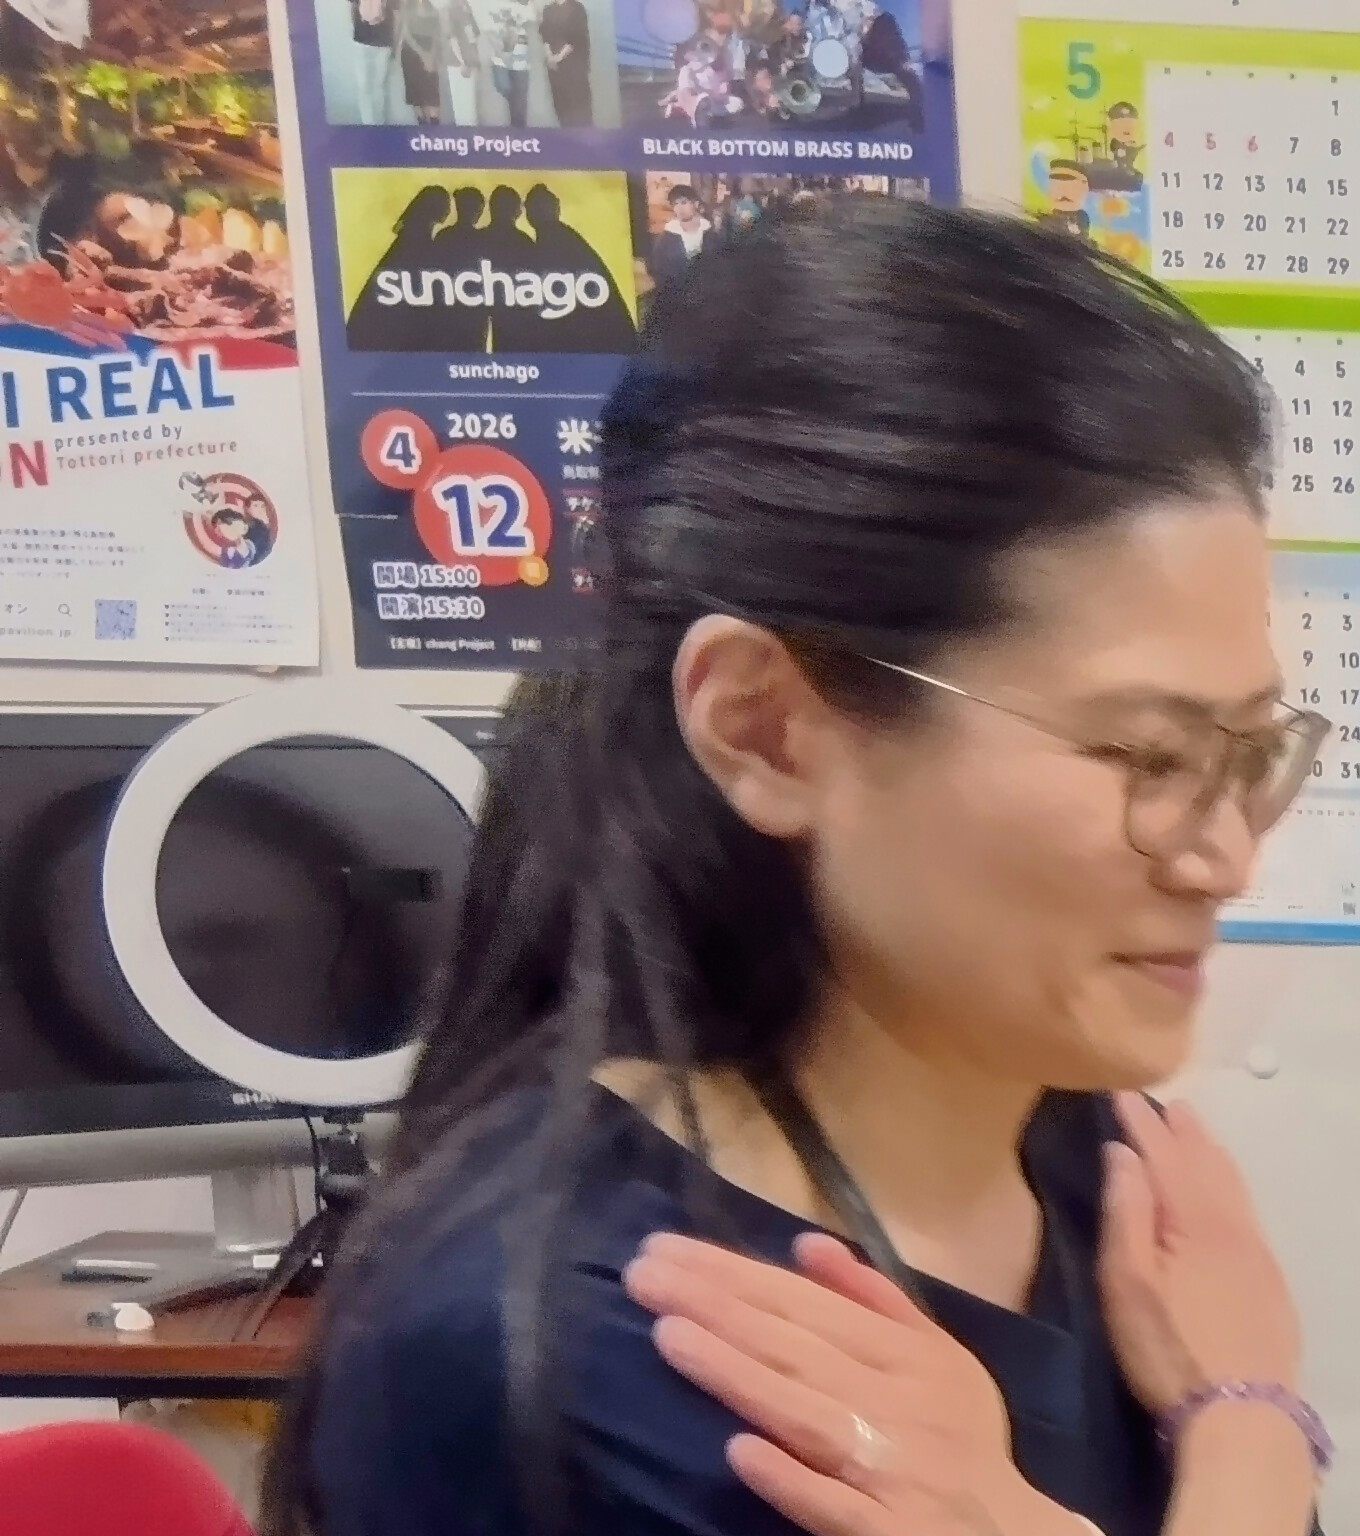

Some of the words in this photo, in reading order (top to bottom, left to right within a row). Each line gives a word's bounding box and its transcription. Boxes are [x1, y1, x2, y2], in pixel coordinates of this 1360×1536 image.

[1065, 41, 1101, 100] 5
[1331, 100, 1340, 116] 1
[410, 134, 469, 156] chang
[473, 135, 541, 156] Project
[642, 137, 704, 157] BLACK
[707, 139, 789, 159] BOTTOM
[793, 139, 854, 159] BRASS
[857, 141, 913, 161] BAND
[1164, 131, 1174, 148] 4
[1205, 132, 1217, 150] 5
[1247, 135, 1259, 153] 6
[1289, 137, 1300, 154] 7
[1330, 139, 1342, 157] 8
[1161, 172, 1181, 188] 11
[1203, 173, 1224, 191] 12
[1244, 174, 1266, 193] 13
[1286, 177, 1307, 195] 14
[1327, 178, 1348, 197] 15
[1162, 210, 1184, 228] 18
[1204, 212, 1225, 230] 19
[1243, 213, 1267, 232] 20
[1284, 216, 1307, 234] 21
[1326, 218, 1349, 236] 22
[1162, 250, 1184, 268] 25
[1203, 251, 1226, 270] 26
[1244, 253, 1266, 271] 27
[1285, 255, 1309, 274] 28
[1327, 257, 1350, 275] 29
[376, 260, 611, 319] sunchago
[449, 361, 540, 384] sunchago
[1294, 360, 1305, 376] 4
[1335, 360, 1346, 379] 5
[46, 354, 236, 423] REAL
[1291, 398, 1311, 416] 11
[1332, 399, 1353, 418] 12
[54, 425, 153, 451] presented
[161, 424, 183, 441] by
[448, 412, 517, 440] 2026
[57, 449, 125, 470] Tottori
[134, 439, 238, 464] prefecture
[383, 428, 419, 471] 4
[1293, 436, 1314, 455] 18
[1333, 438, 1354, 456] 19
[1291, 474, 1314, 493] 25
[1332, 476, 1355, 494] 26
[437, 480, 532, 551] 12
[1301, 612, 1312, 631] 2
[1342, 614, 1353, 632] 3
[1303, 650, 1314, 667] 9
[1339, 651, 1360, 669] 10
[1300, 687, 1321, 705] 16
[1340, 689, 1360, 706] 17
[1339, 725, 1360, 743] 24
[1340, 761, 1360, 780] 31
